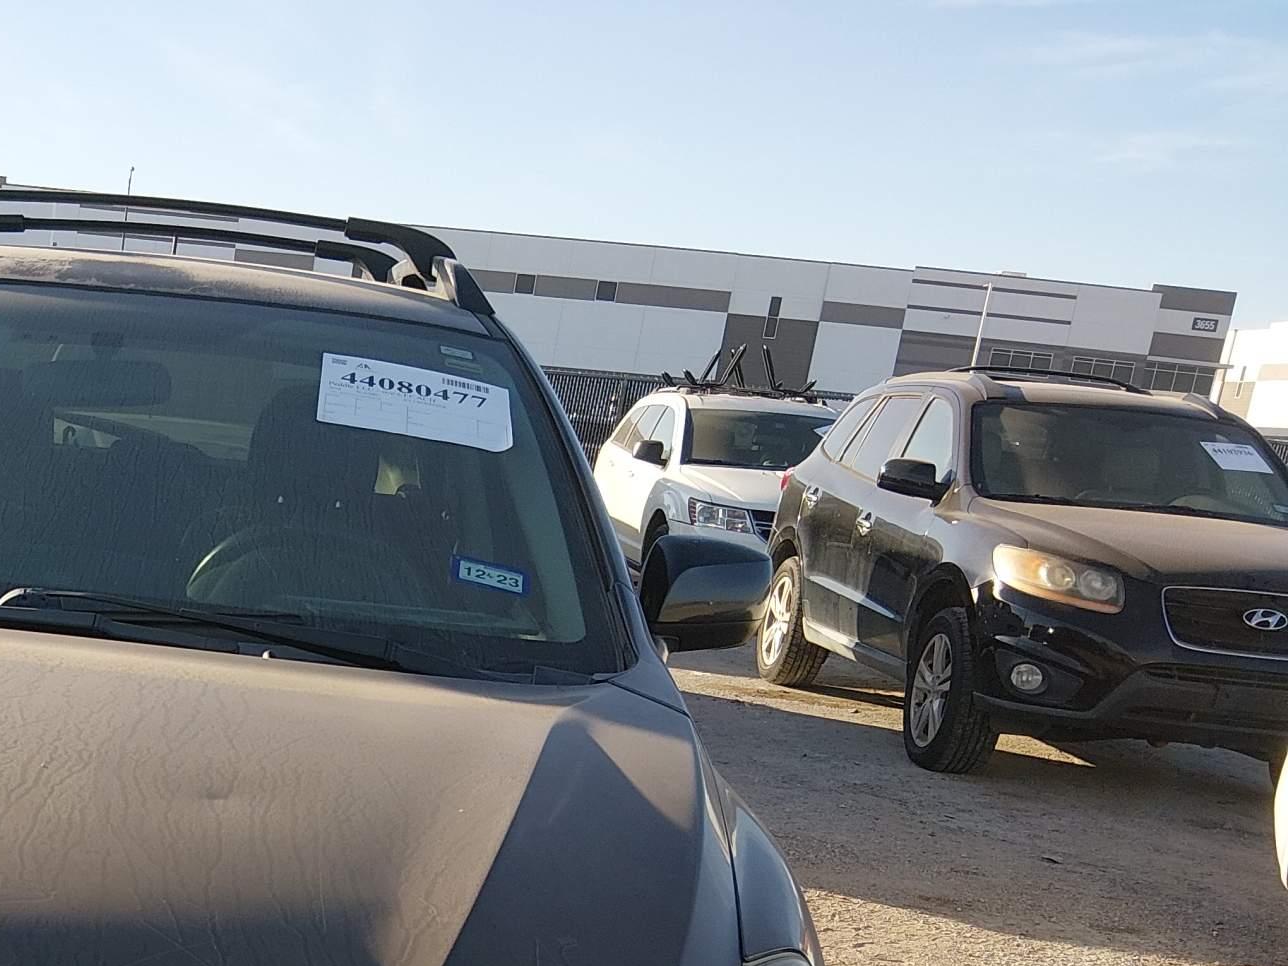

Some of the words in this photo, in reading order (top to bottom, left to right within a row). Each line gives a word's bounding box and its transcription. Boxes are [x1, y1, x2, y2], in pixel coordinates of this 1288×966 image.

[341, 371, 488, 408] 44080477
[464, 566, 487, 579] 12
[496, 574, 520, 588] 23
